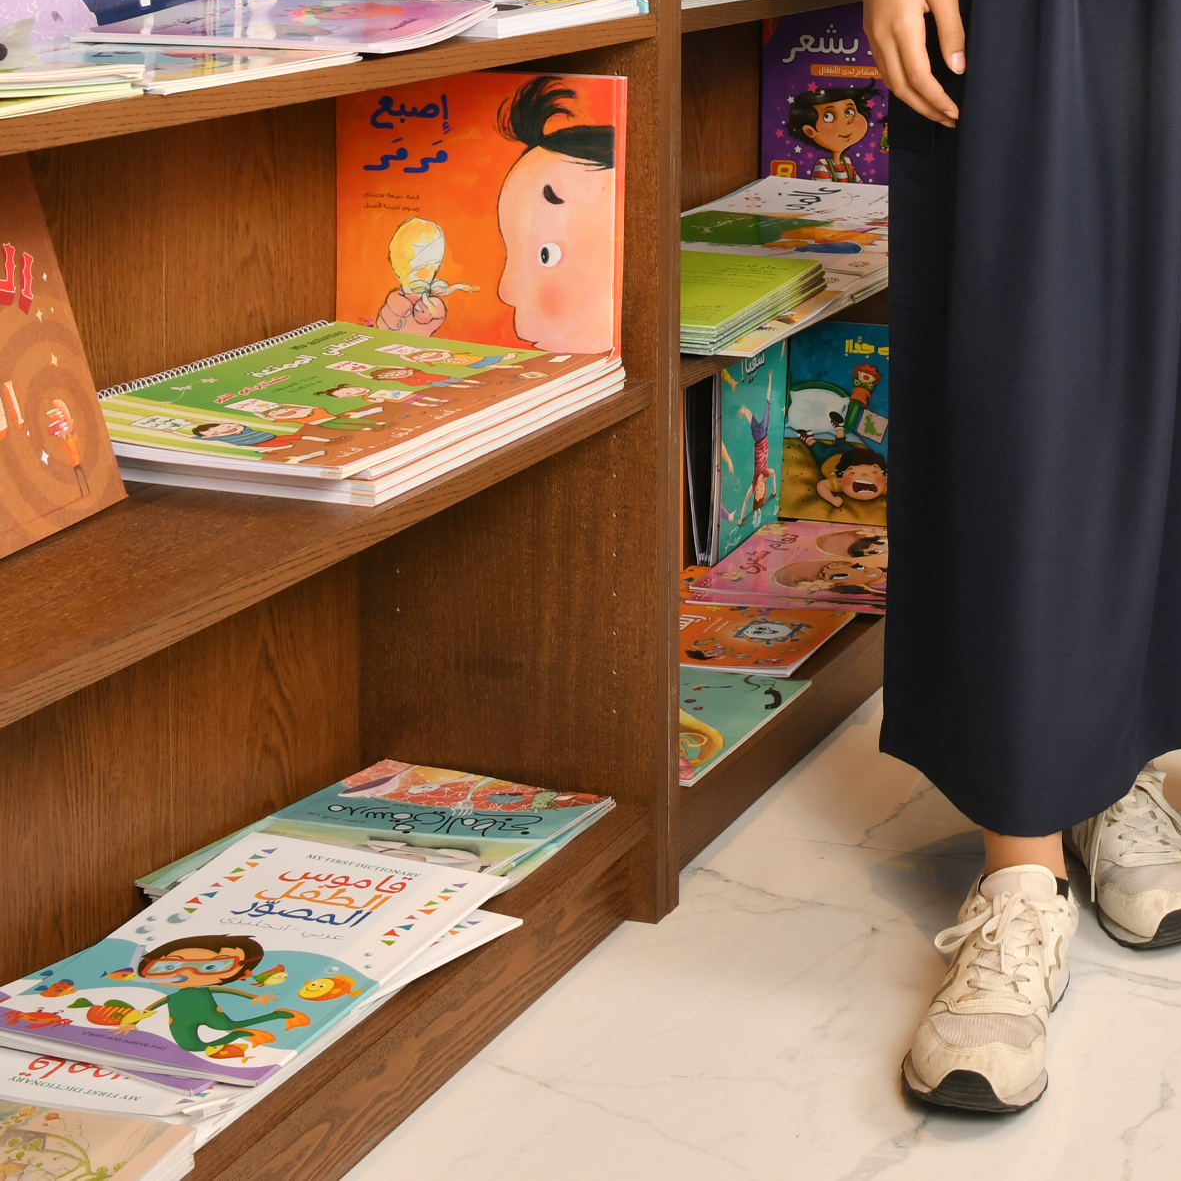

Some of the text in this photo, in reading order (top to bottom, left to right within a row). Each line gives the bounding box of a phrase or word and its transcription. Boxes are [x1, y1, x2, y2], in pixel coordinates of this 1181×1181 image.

[782, 23, 859, 63] يشعر
[818, 65, 841, 76] الأطفال
[305, 853, 422, 878] MY FIRST DICTIONARY
[278, 870, 413, 894] قاموس
[254, 881, 393, 912] الطفل
[301, 930, 344, 941] عربي
[8, 1075, 142, 1102] MY FIRST DICTIONARY
